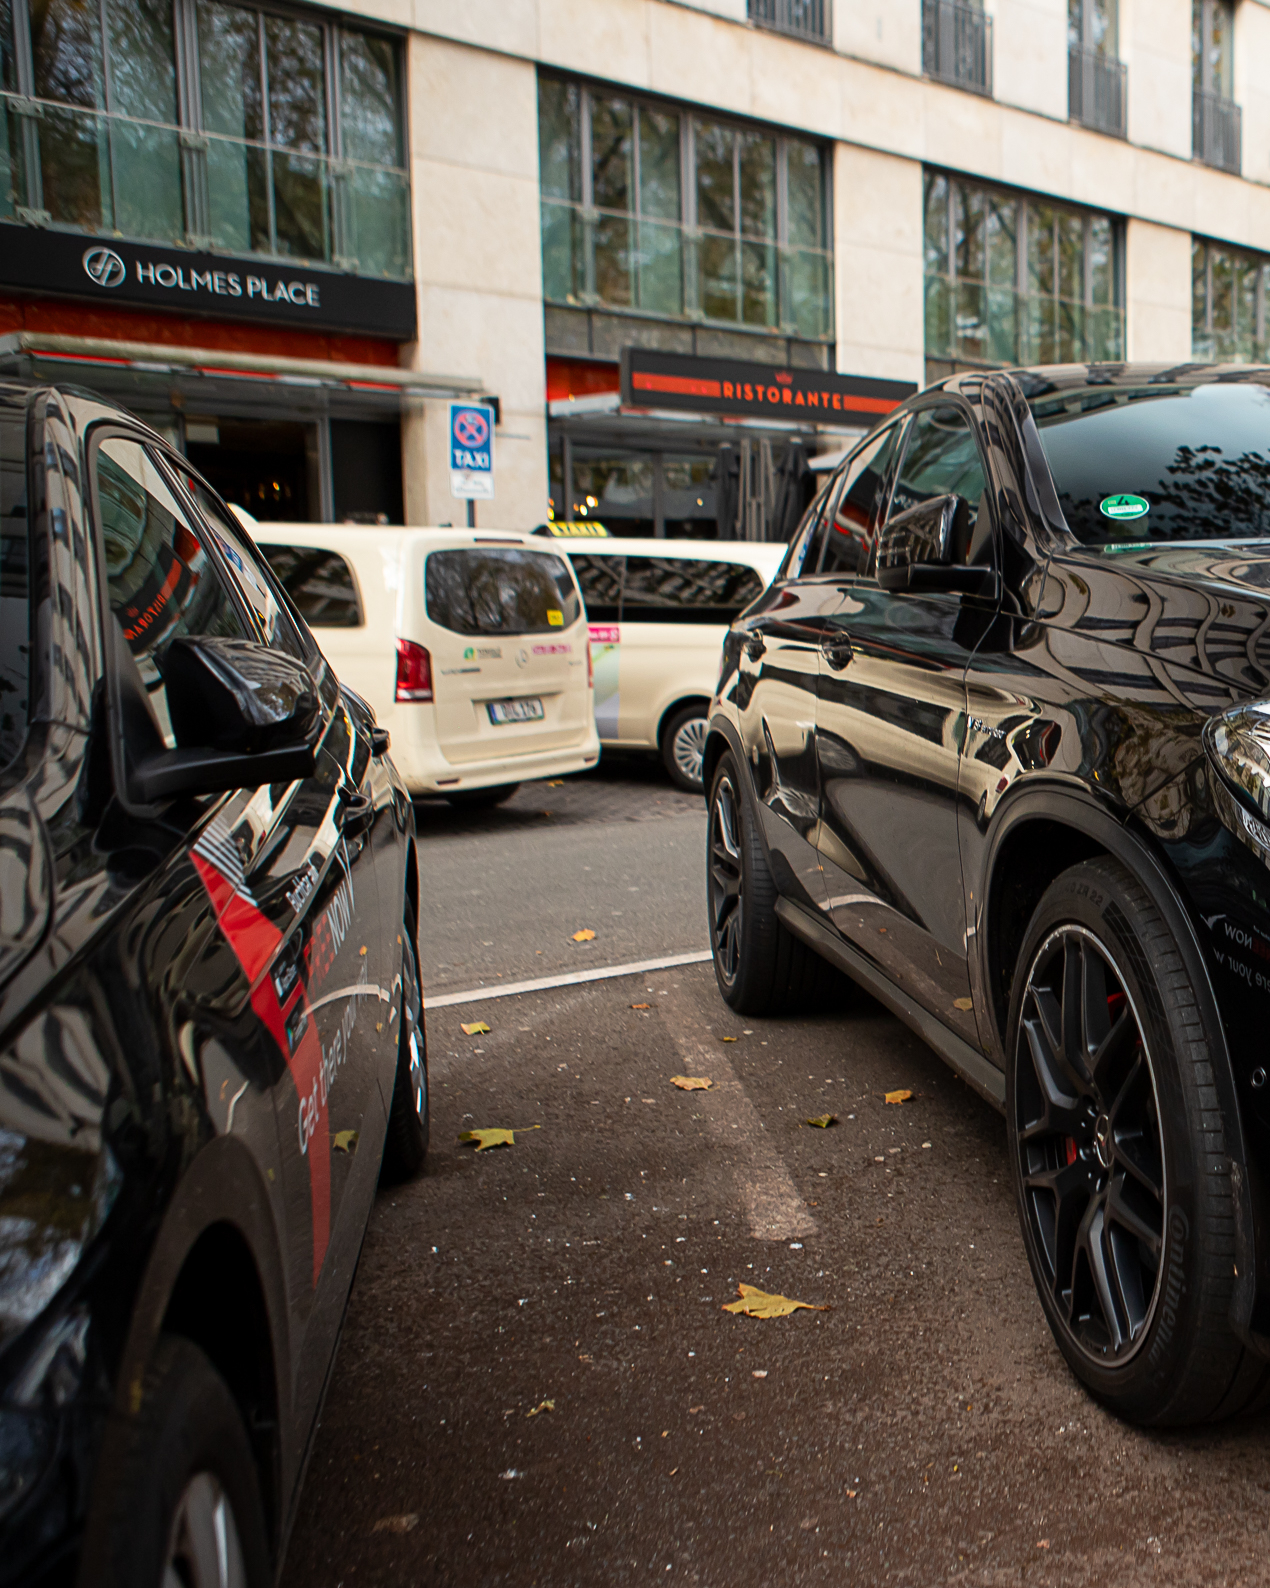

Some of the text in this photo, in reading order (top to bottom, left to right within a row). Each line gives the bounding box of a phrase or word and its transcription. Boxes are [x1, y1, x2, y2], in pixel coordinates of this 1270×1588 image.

[136, 260, 321, 307] HOLMES PLACE
[722, 381, 843, 410] RISTORANTE
[453, 448, 490, 469] TAXI
[326, 881, 352, 955] NOW
[1089, 888, 1104, 907] 22
[298, 1076, 320, 1156] Get
[1147, 1205, 1190, 1367] Continental
